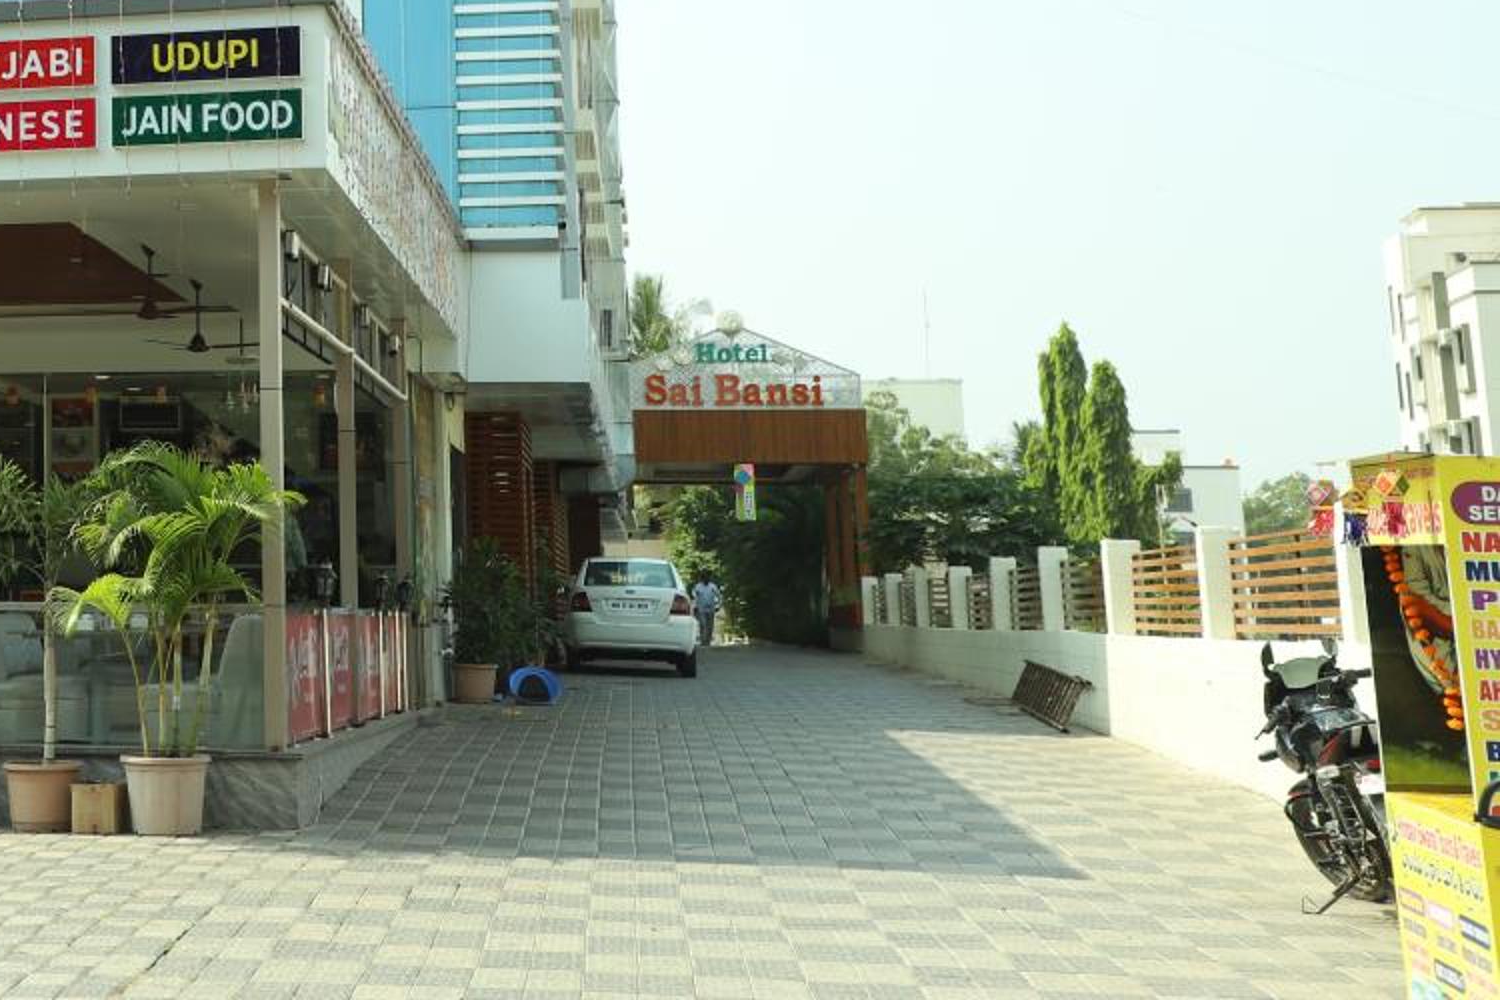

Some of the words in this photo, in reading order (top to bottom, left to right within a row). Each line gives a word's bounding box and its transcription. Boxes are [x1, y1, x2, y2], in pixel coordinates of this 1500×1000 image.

[152, 39, 259, 73] UDUPI
[121, 105, 194, 137] JAIN
[202, 101, 294, 133] FOOD
[695, 343, 768, 363] Hotel
[644, 373, 703, 406] Sai
[714, 373, 824, 407] Bansi
